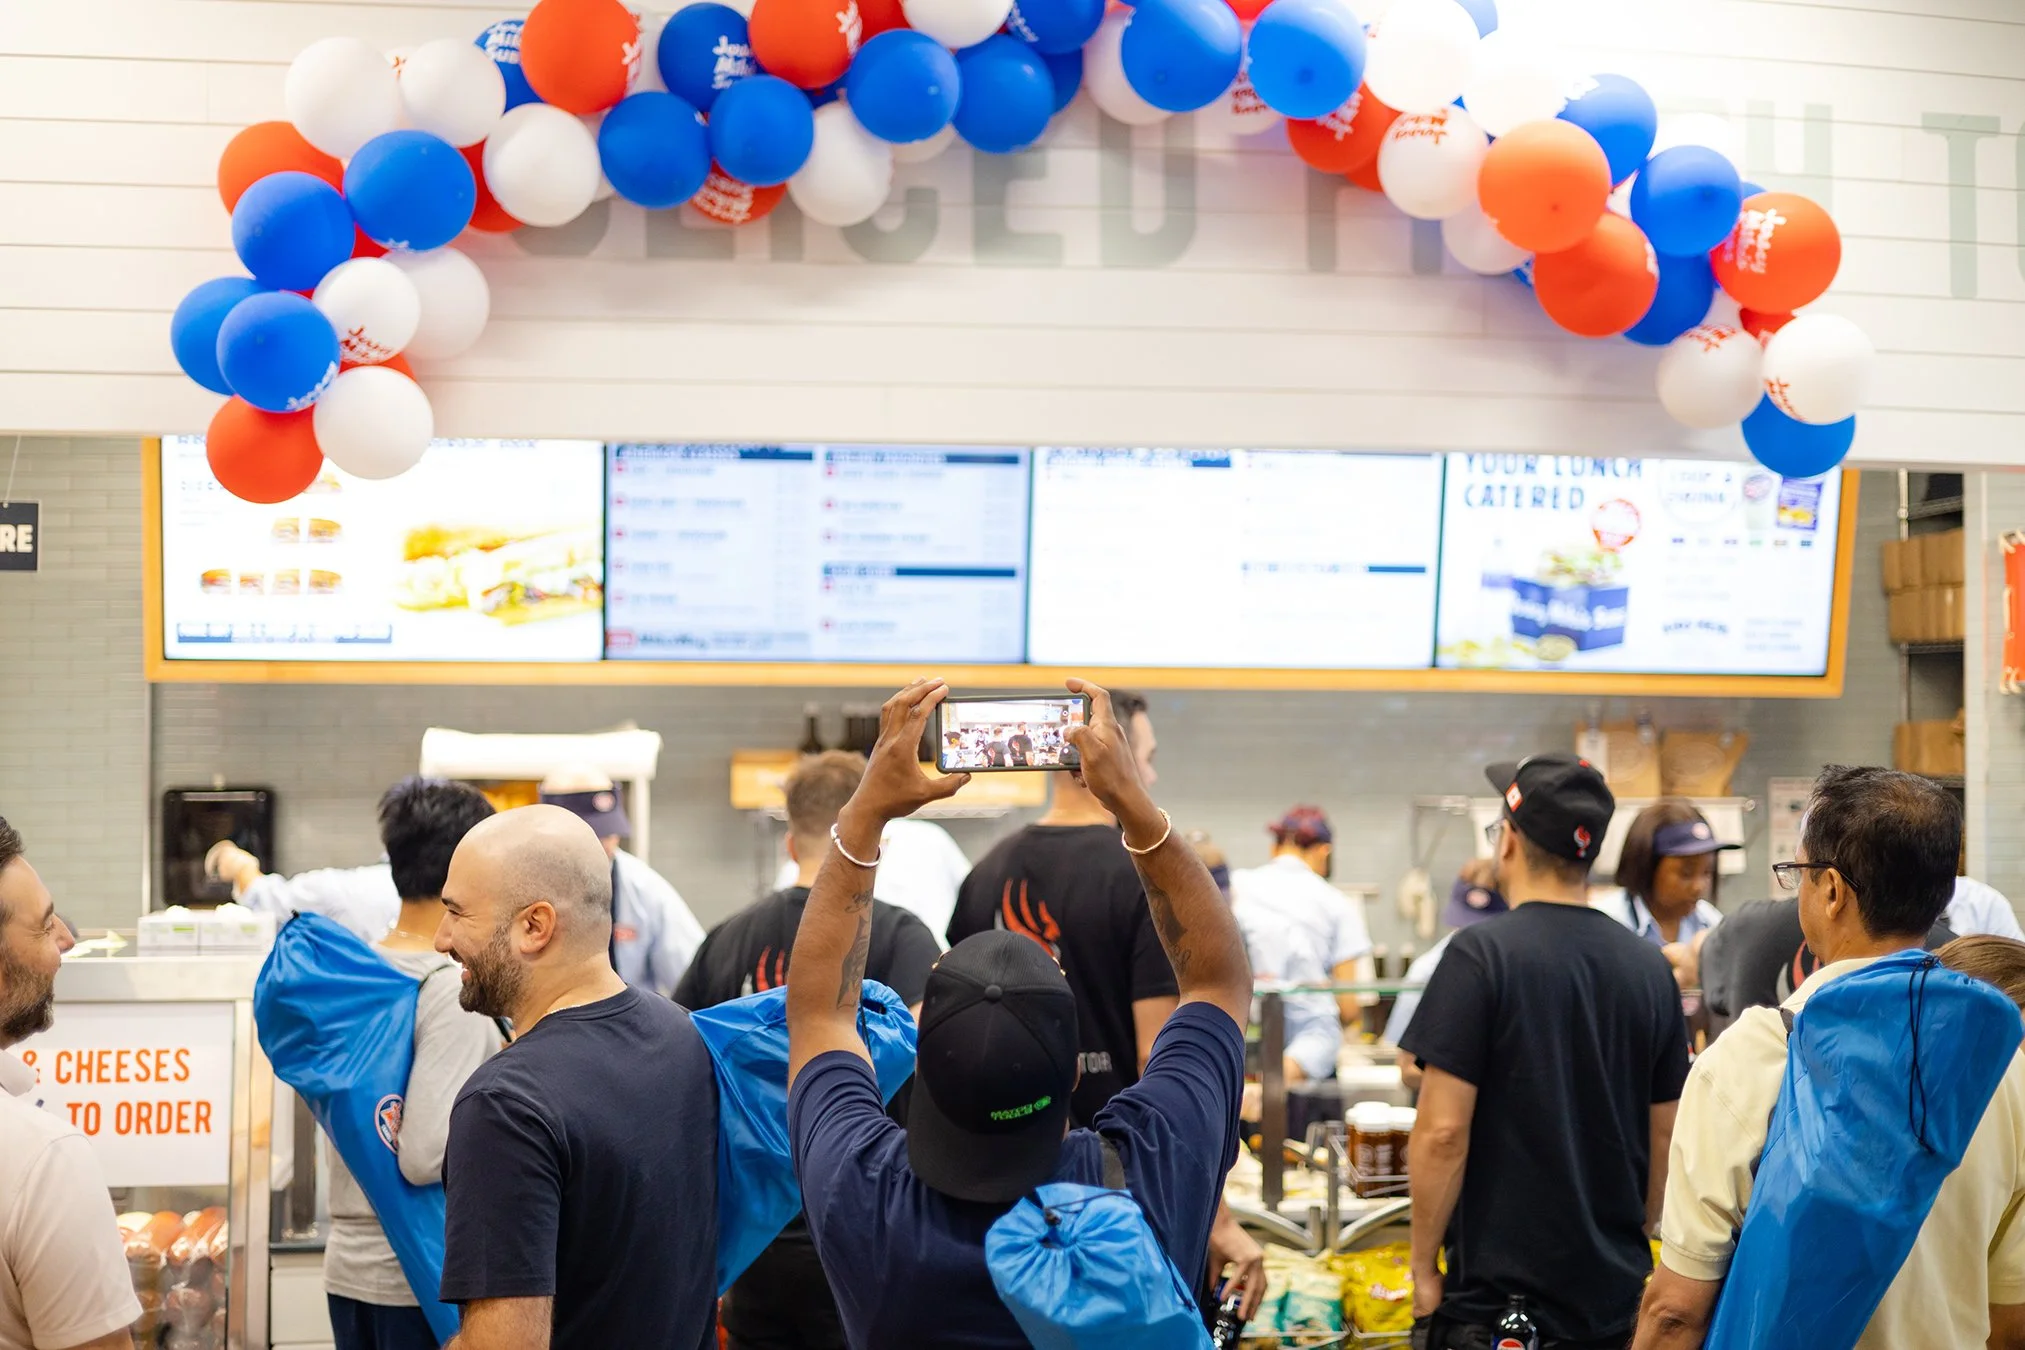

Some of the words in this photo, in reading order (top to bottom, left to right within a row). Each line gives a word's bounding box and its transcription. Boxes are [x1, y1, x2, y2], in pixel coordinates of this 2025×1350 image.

[1921, 111, 2025, 300] T
[1466, 453, 1539, 475] YOUR
[1464, 484, 1585, 510] CATERED
[55, 1047, 191, 1085] CHEESES
[66, 1100, 101, 1137] TO
[114, 1100, 213, 1137] ORDER
